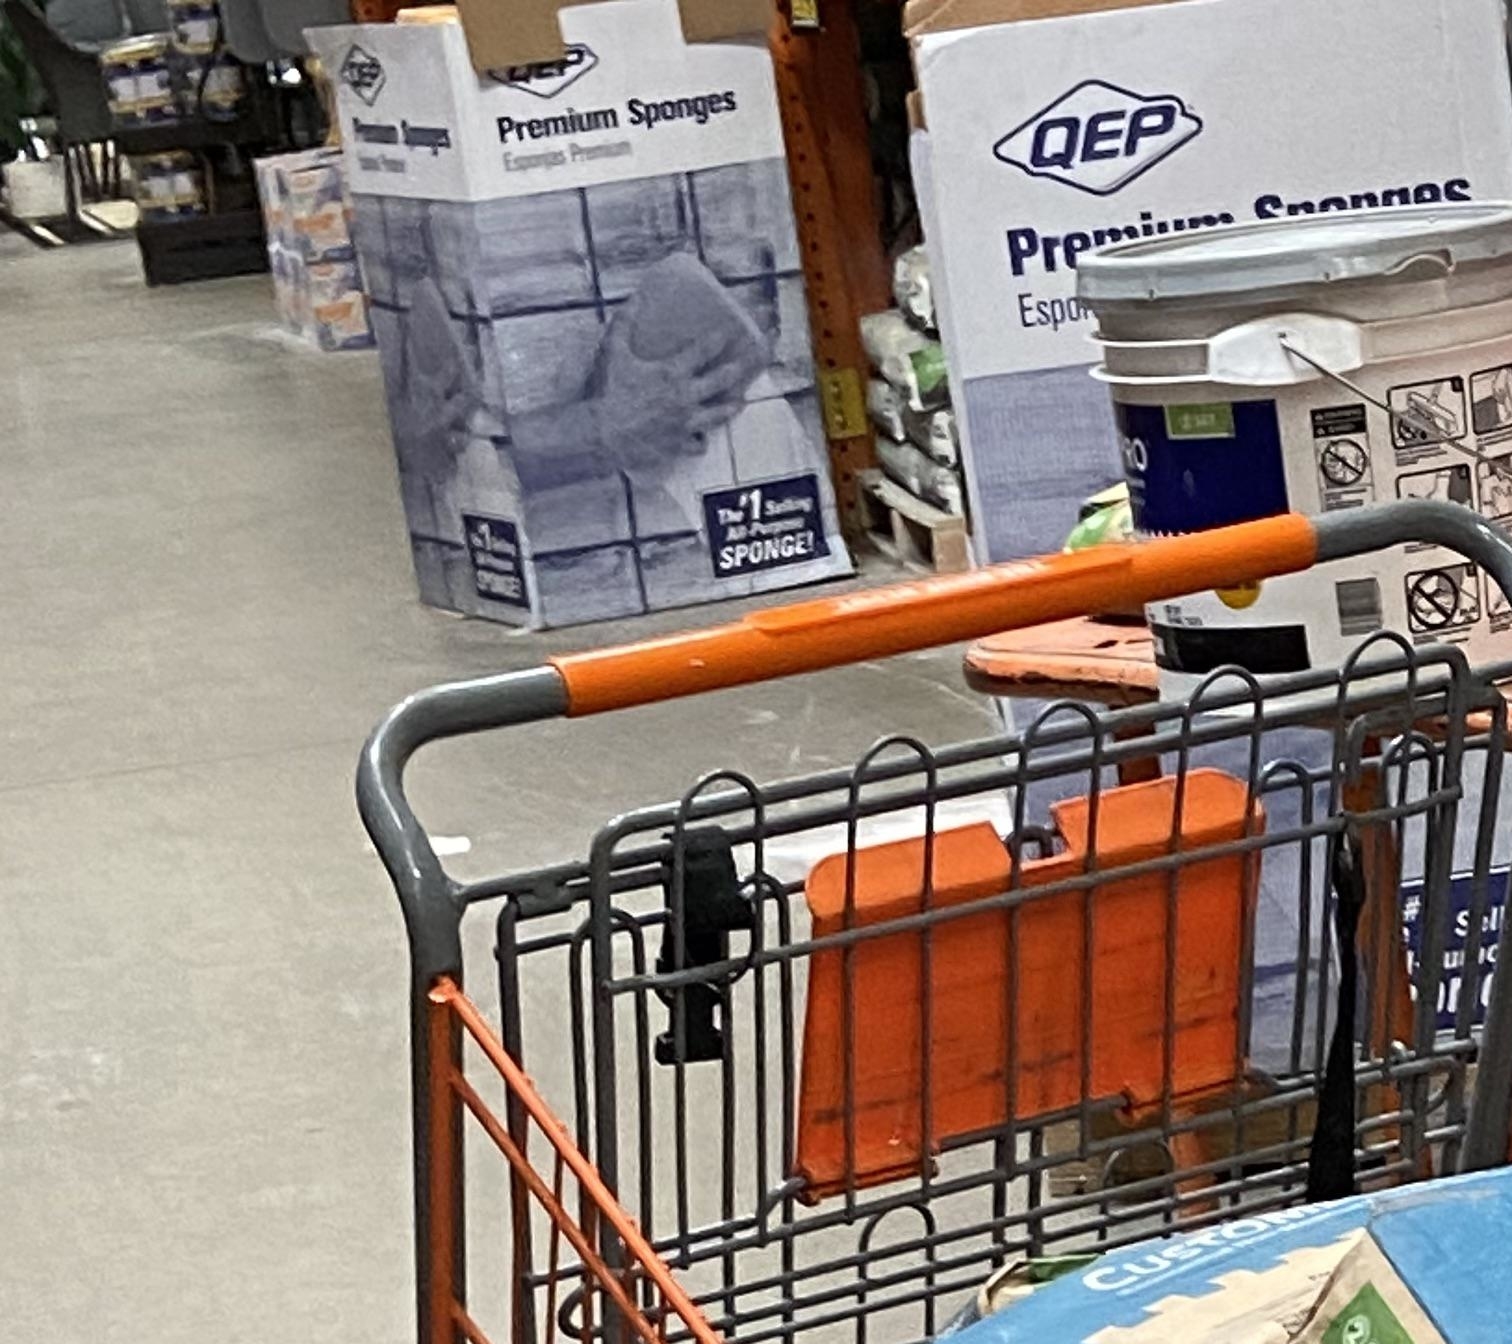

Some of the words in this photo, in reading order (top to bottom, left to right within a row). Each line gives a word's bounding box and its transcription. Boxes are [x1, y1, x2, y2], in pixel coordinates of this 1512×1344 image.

[496, 107, 620, 143] Premium
[627, 90, 737, 127] Sponges
[1029, 104, 1177, 170] QEP
[719, 531, 815, 570] SPONGE!
